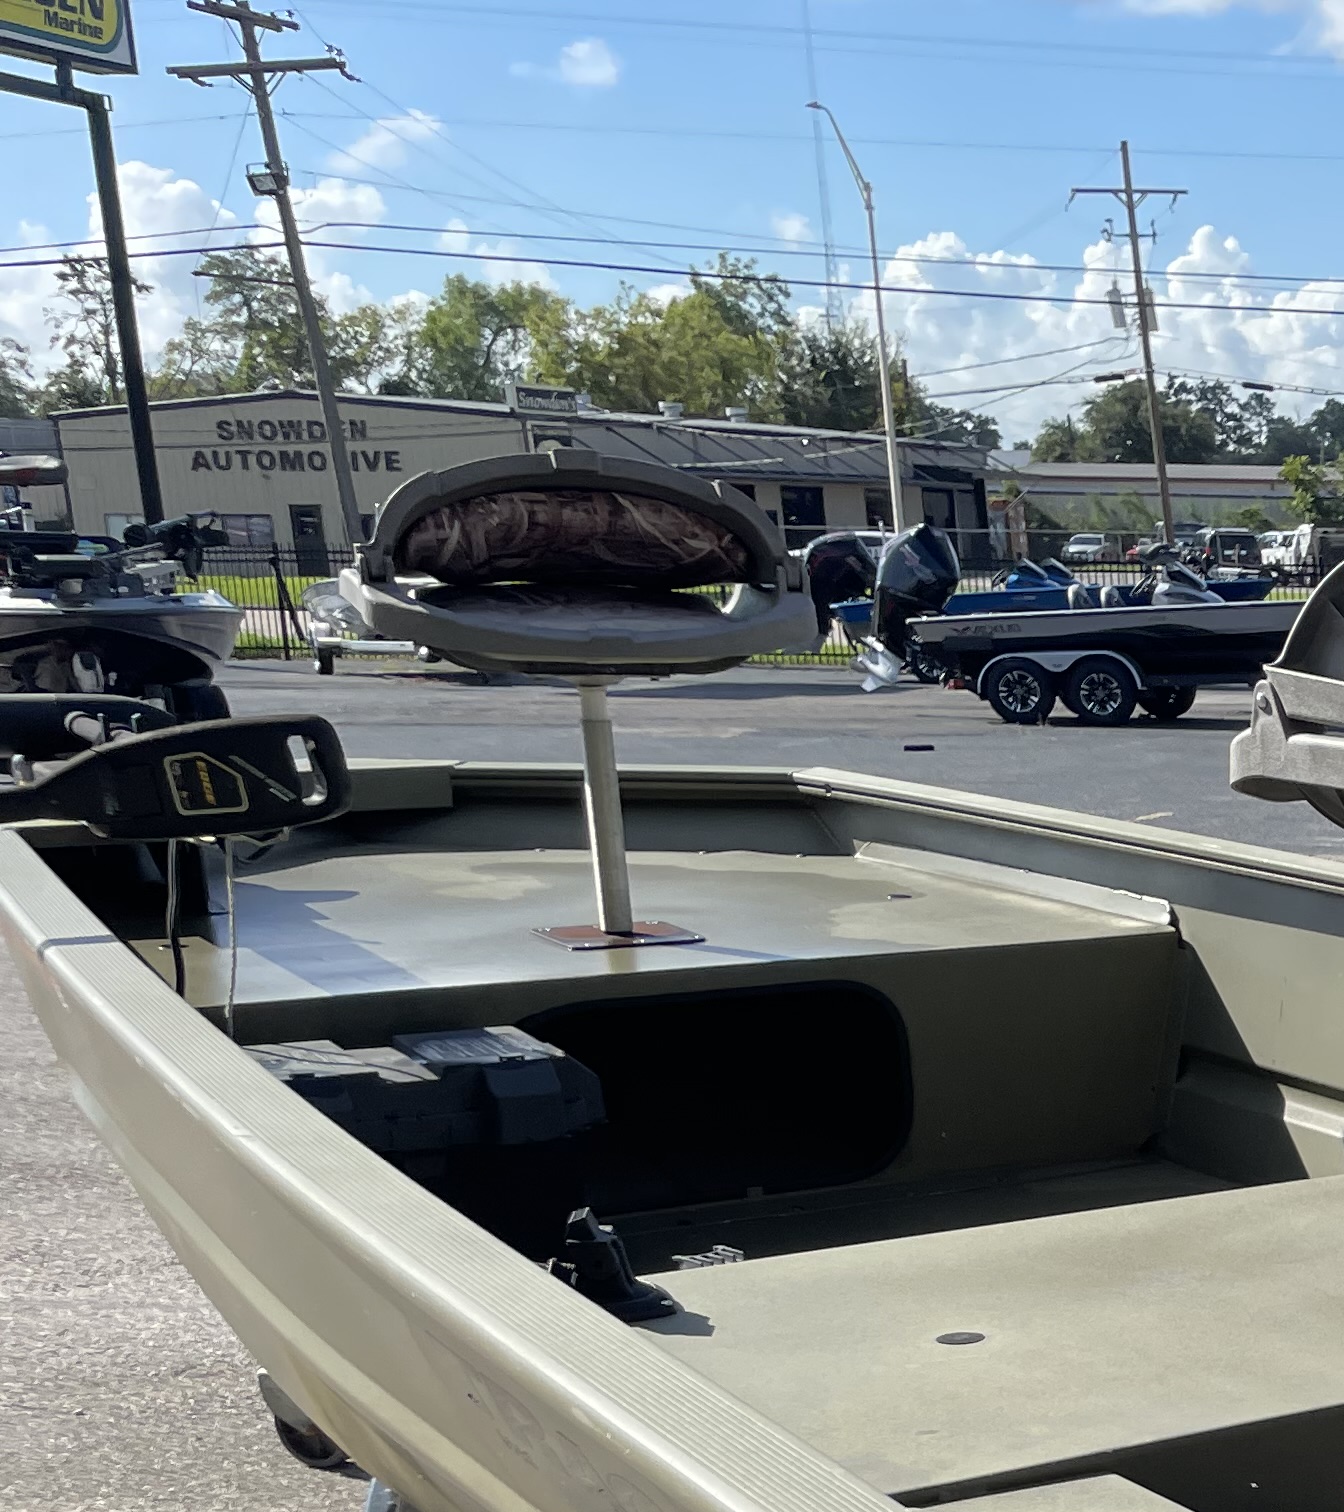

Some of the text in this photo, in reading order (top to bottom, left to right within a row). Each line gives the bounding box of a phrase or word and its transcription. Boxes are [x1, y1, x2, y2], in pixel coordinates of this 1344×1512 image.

[44, 9, 104, 40] Marine
[216, 419, 368, 441] SNOWDN
[191, 450, 403, 473] AUTOMOIVE
